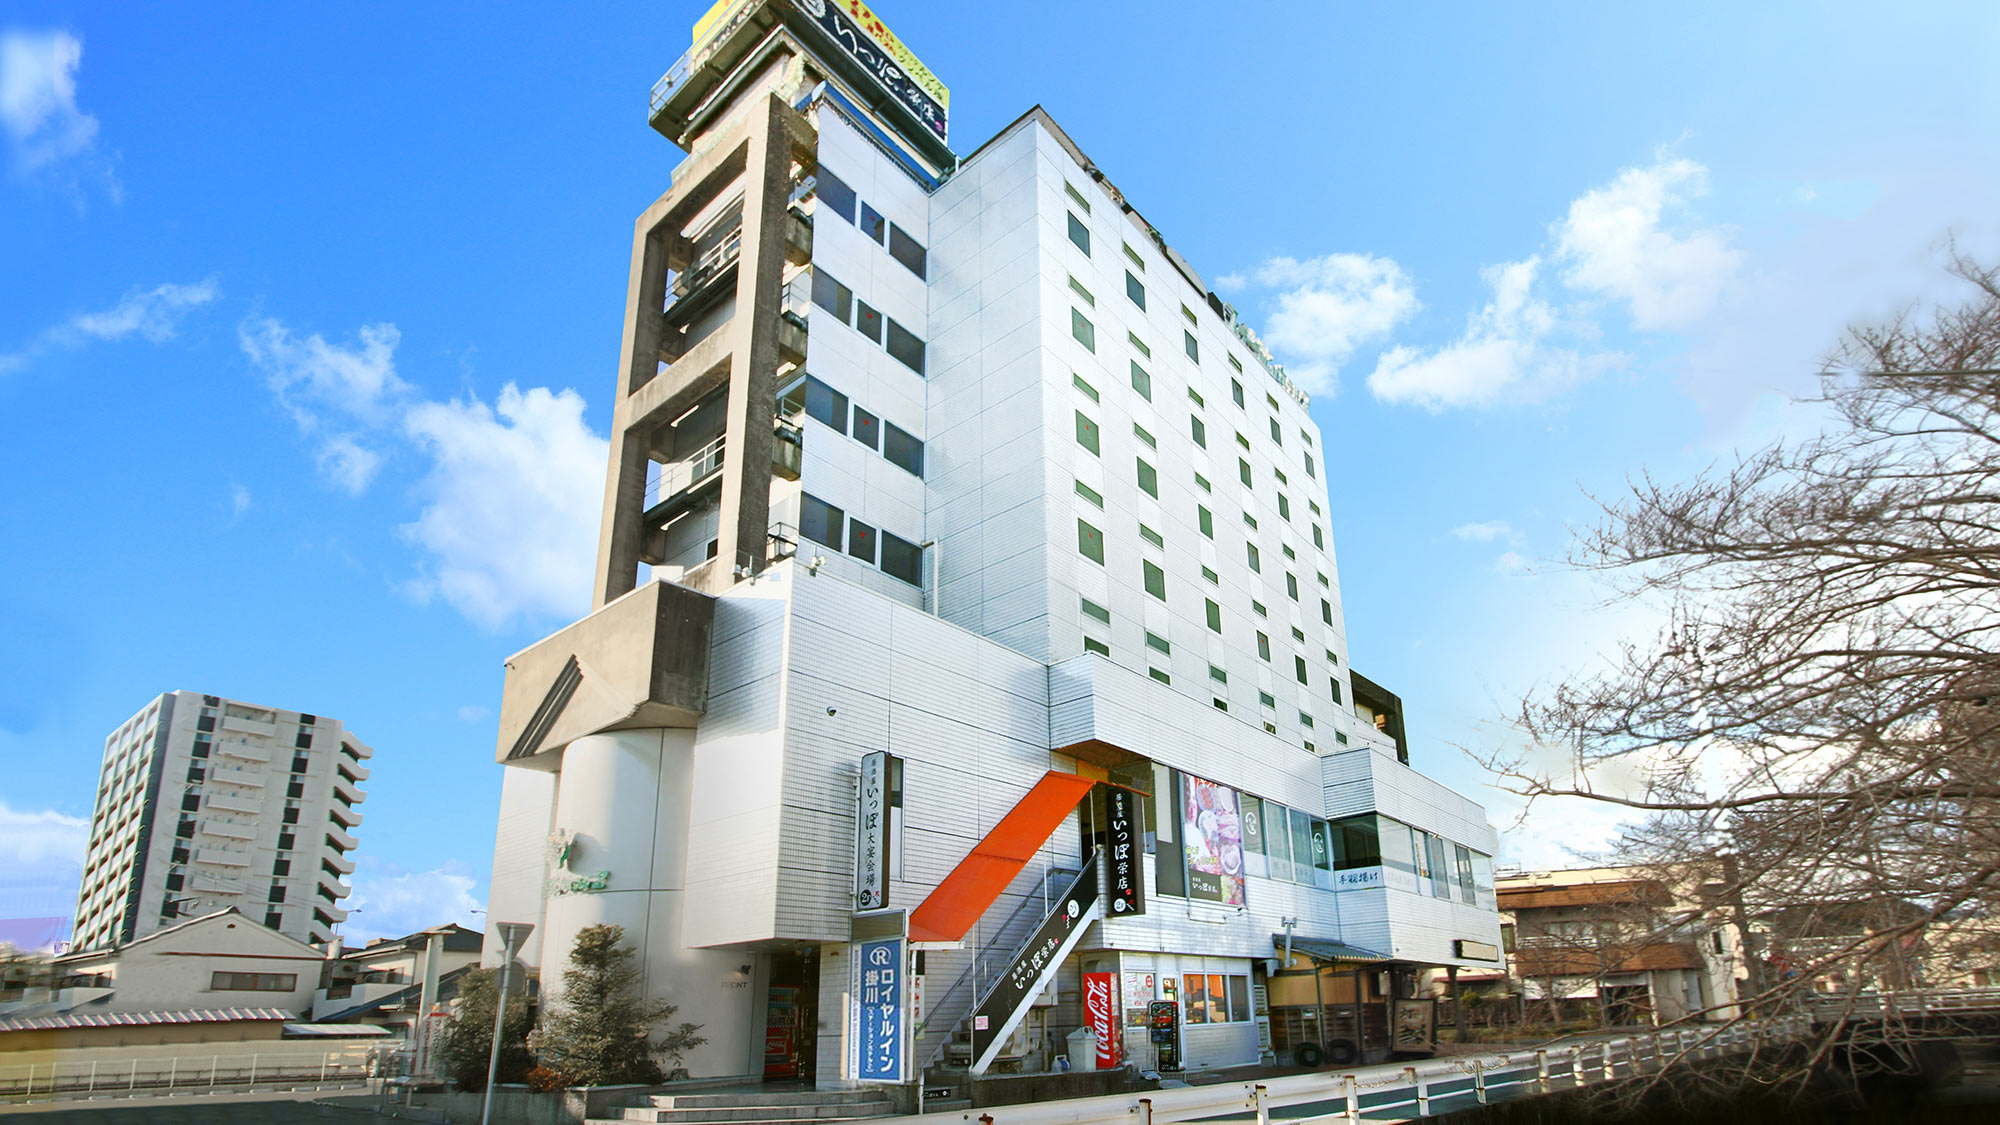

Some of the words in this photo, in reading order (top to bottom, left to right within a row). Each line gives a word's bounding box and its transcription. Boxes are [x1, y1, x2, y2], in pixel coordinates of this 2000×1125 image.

[865, 969, 879, 1004] 掛川
[880, 969, 895, 1073] ロイヤルイン
